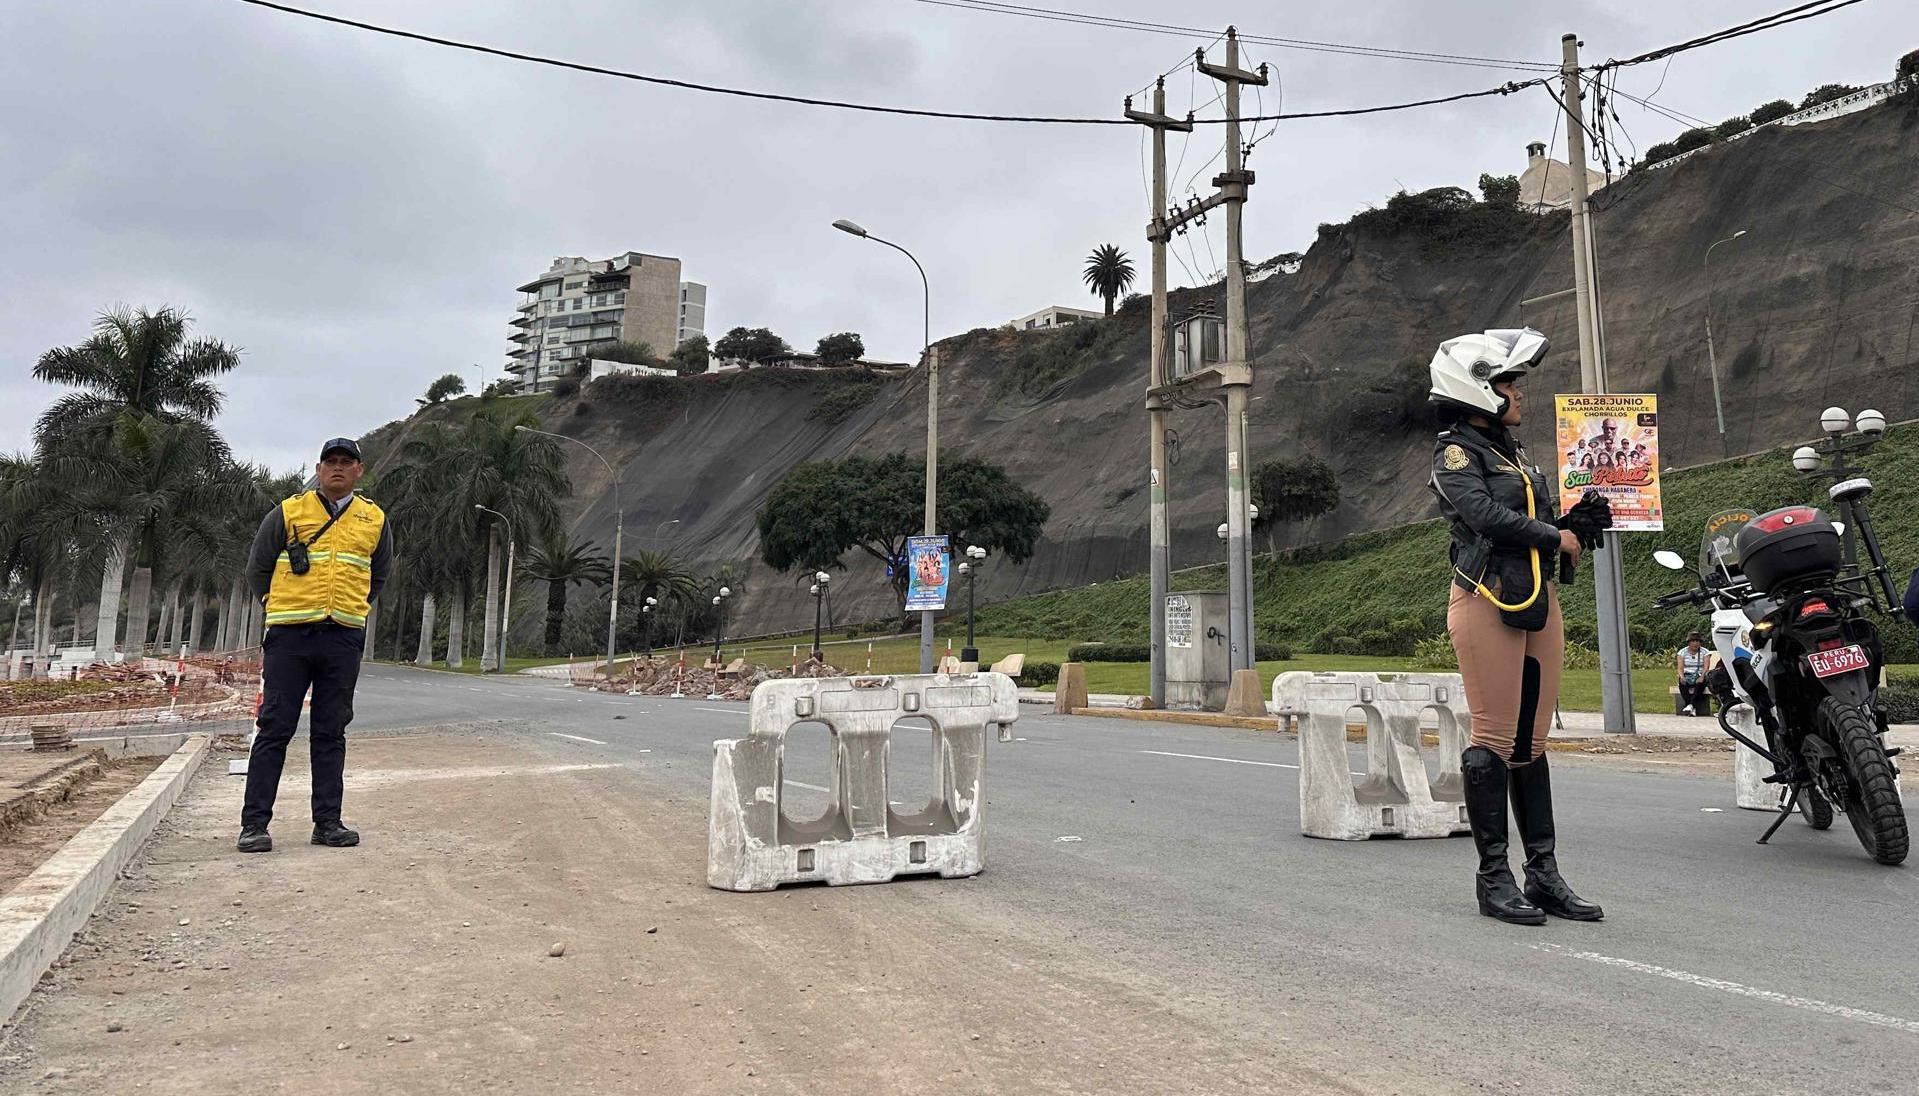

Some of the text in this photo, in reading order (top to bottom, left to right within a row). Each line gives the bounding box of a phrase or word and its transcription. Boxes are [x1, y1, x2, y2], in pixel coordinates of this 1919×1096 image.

[1567, 398, 1643, 406] SAB.28.JUNIO
[1565, 470, 1592, 489] San
[1823, 648, 1845, 658] PERU
[1813, 652, 1863, 673] EU-6976
